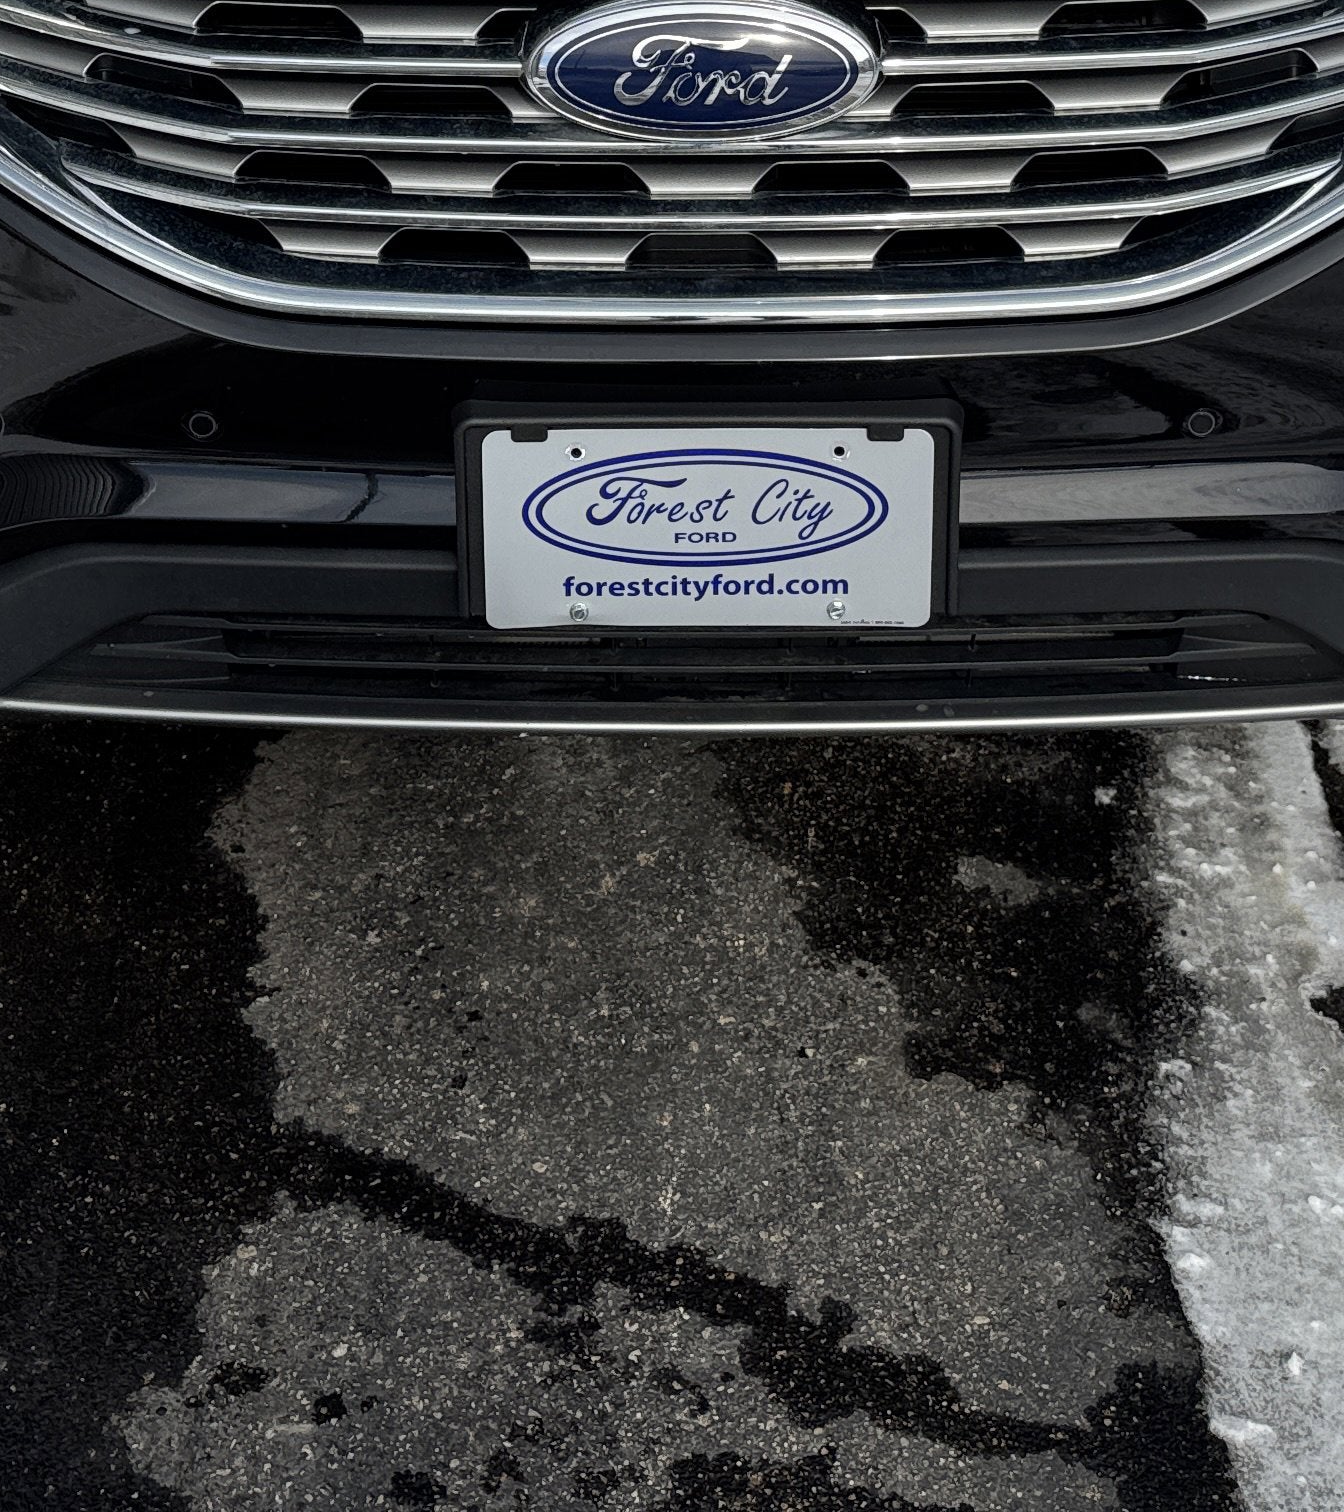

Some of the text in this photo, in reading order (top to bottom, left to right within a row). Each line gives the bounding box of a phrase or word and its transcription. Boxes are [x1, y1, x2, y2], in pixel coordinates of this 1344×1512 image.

[614, 34, 792, 106] Ford
[585, 477, 834, 541] Forest City
[674, 532, 737, 544] FORD
[563, 573, 849, 601] forestcityford.com
